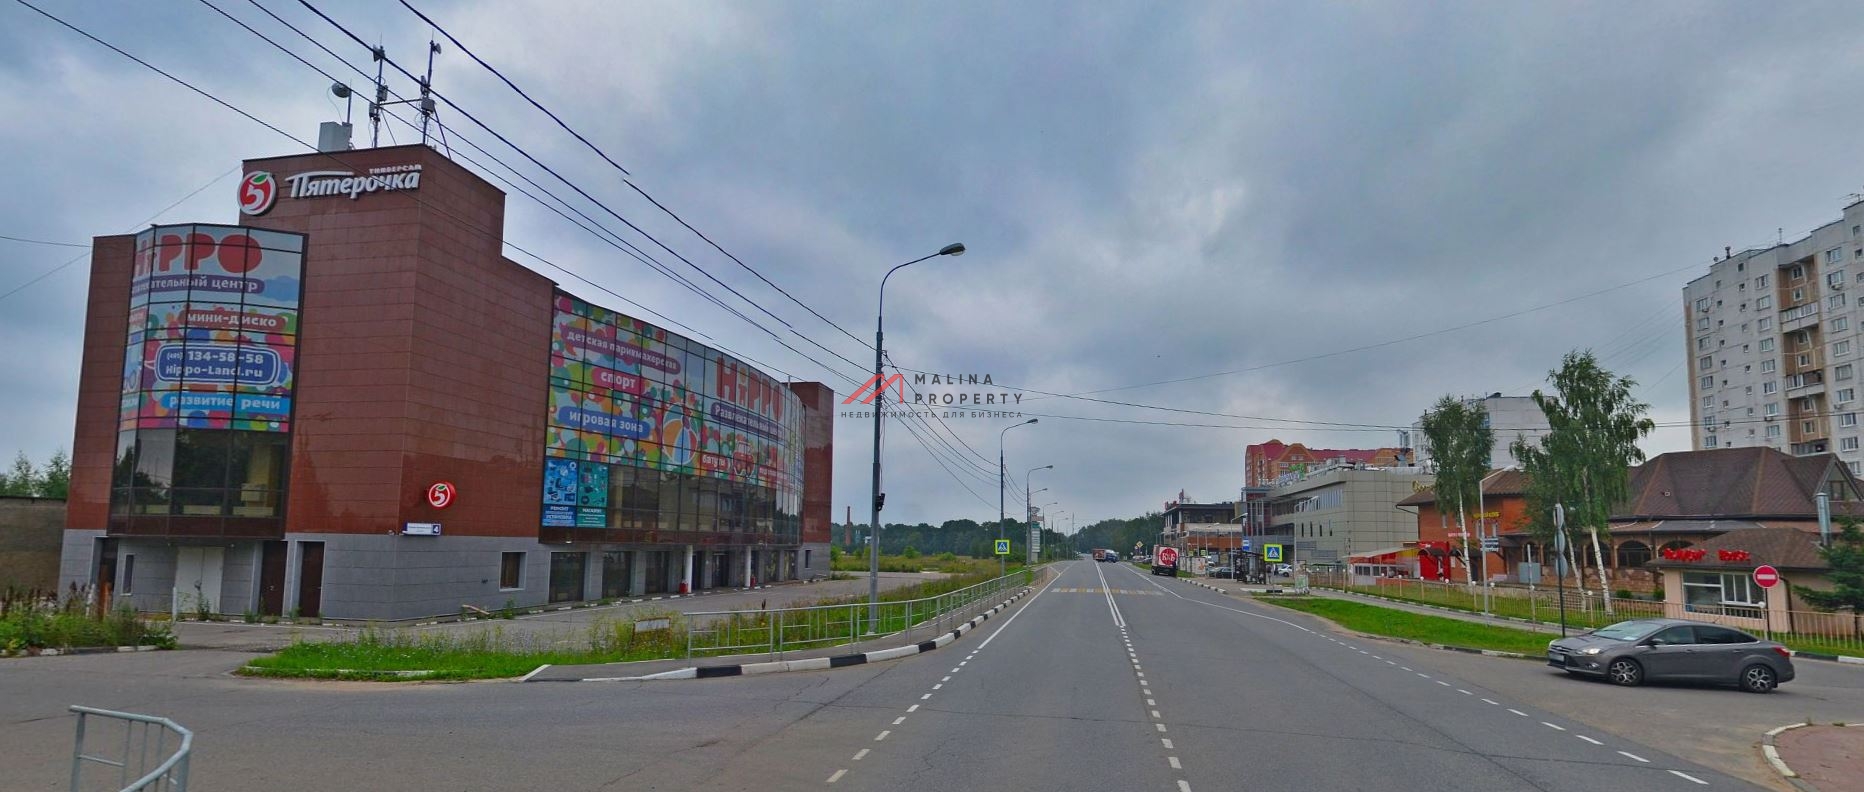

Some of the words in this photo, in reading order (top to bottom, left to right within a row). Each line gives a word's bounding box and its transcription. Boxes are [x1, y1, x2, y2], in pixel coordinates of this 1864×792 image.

[285, 170, 421, 200] Пятерочка
[211, 278, 258, 293] центр
[187, 312, 278, 328] мини-диско
[566, 330, 608, 349] детская
[187, 350, 264, 364] 134-58-58
[600, 371, 636, 390] спорт
[169, 396, 234, 411] развитие
[241, 397, 281, 410] речи
[569, 411, 617, 428] игровая
[619, 420, 643, 433] зона
